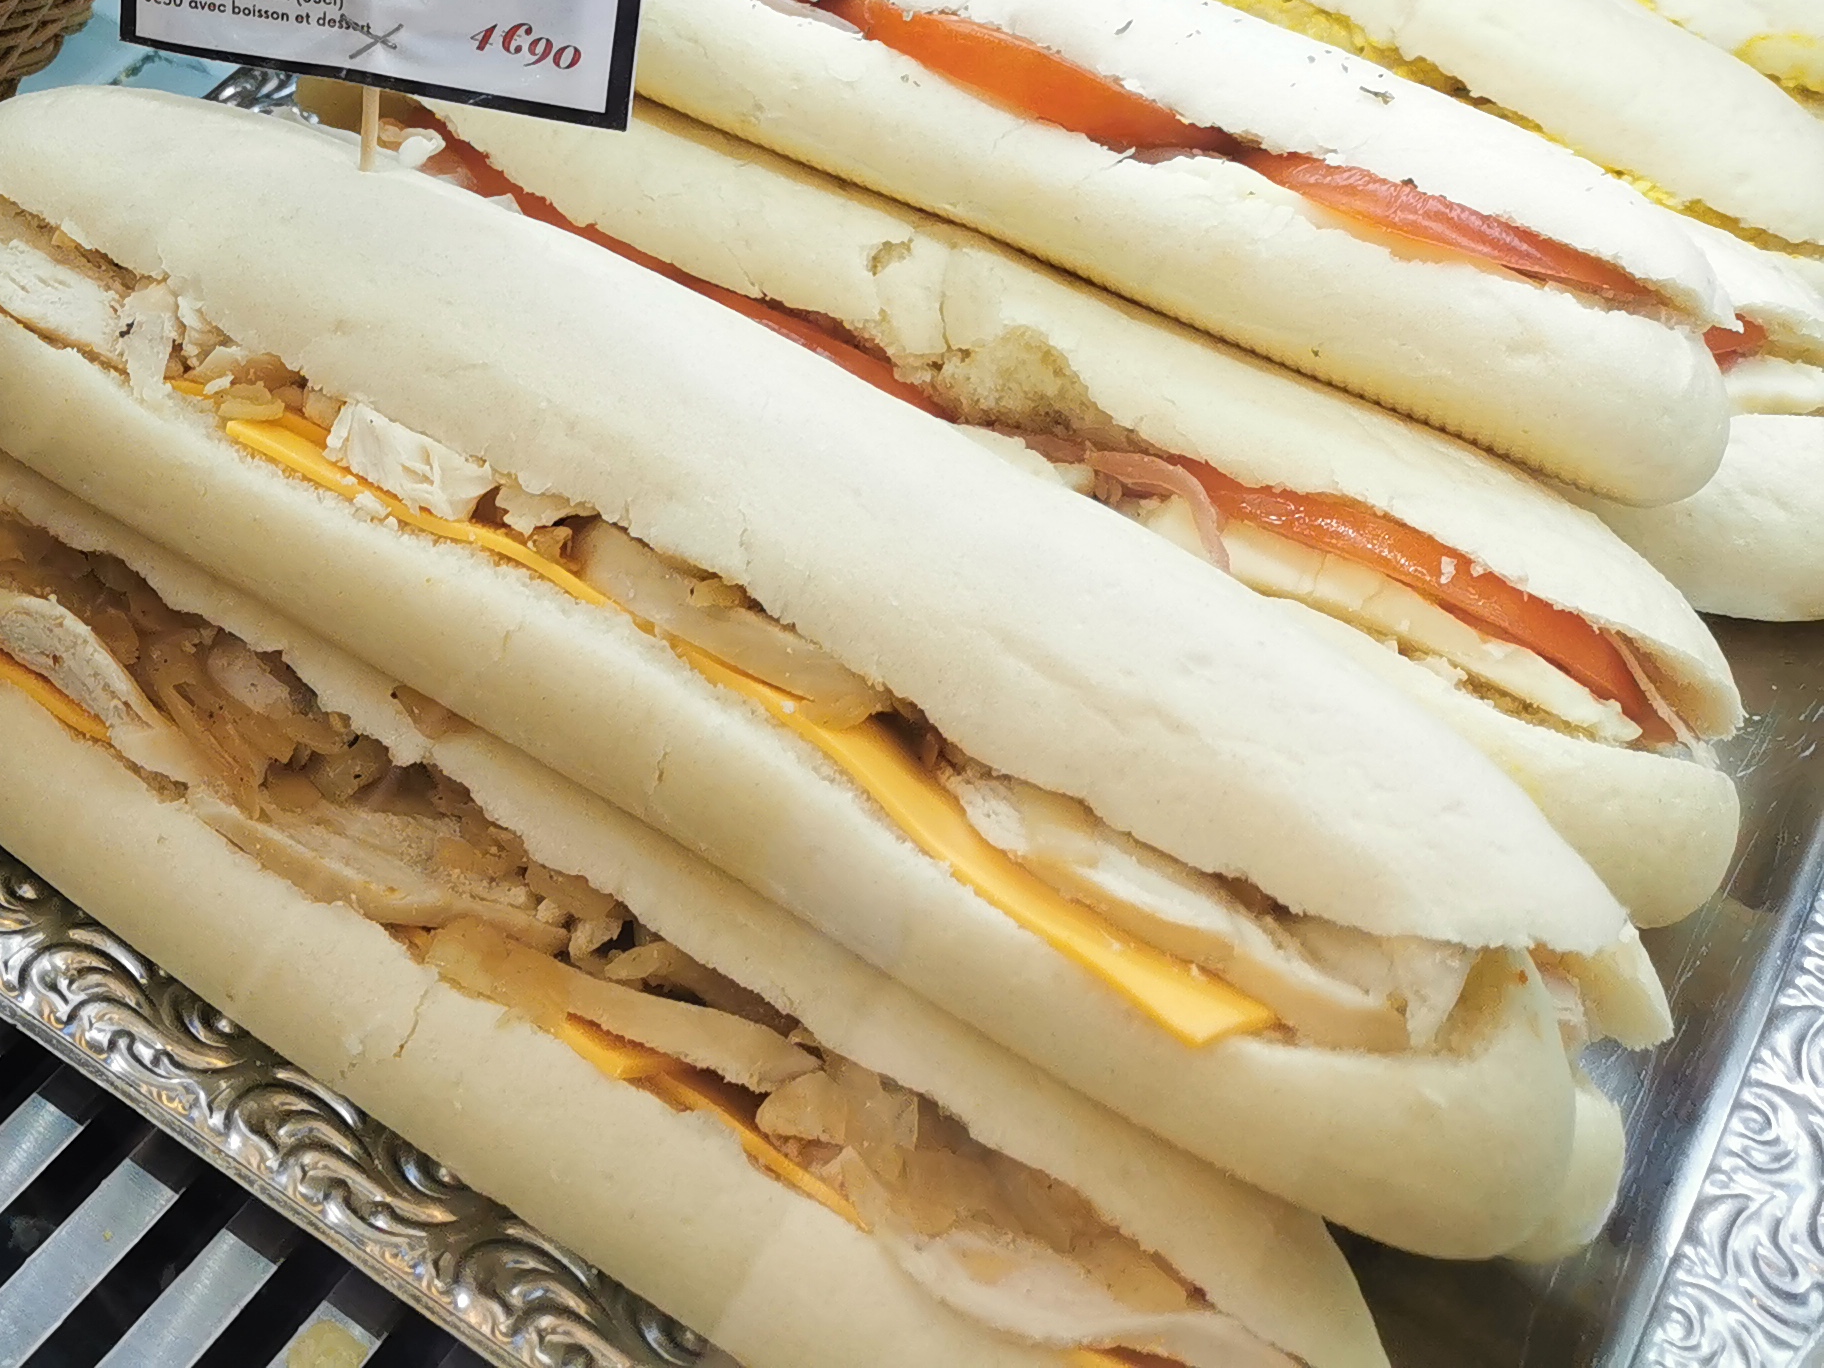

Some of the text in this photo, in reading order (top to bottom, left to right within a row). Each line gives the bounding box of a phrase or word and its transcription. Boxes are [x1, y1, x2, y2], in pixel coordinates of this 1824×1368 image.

[231, 0, 290, 24] boisson
[294, 8, 312, 26] et
[470, 22, 582, 70] 4€90
